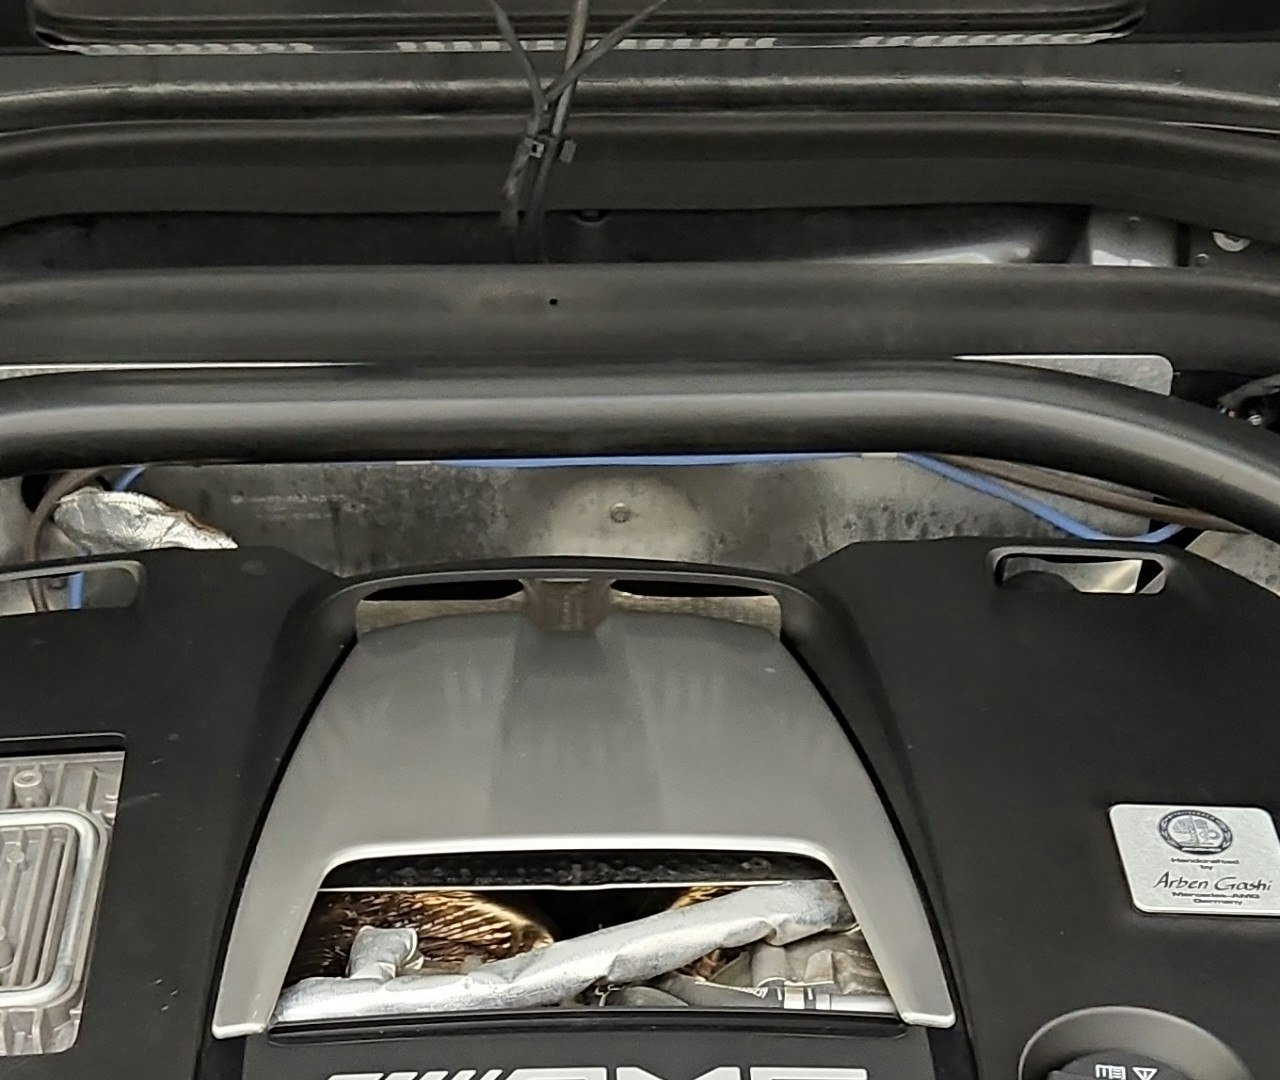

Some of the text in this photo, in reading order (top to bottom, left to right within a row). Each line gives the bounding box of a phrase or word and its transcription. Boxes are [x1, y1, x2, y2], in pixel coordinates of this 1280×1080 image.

[1171, 857, 1239, 865] Handcrafted
[1153, 871, 1273, 891] Arben Gashi
[1172, 891, 1260, 899] Mercedes-AMG
